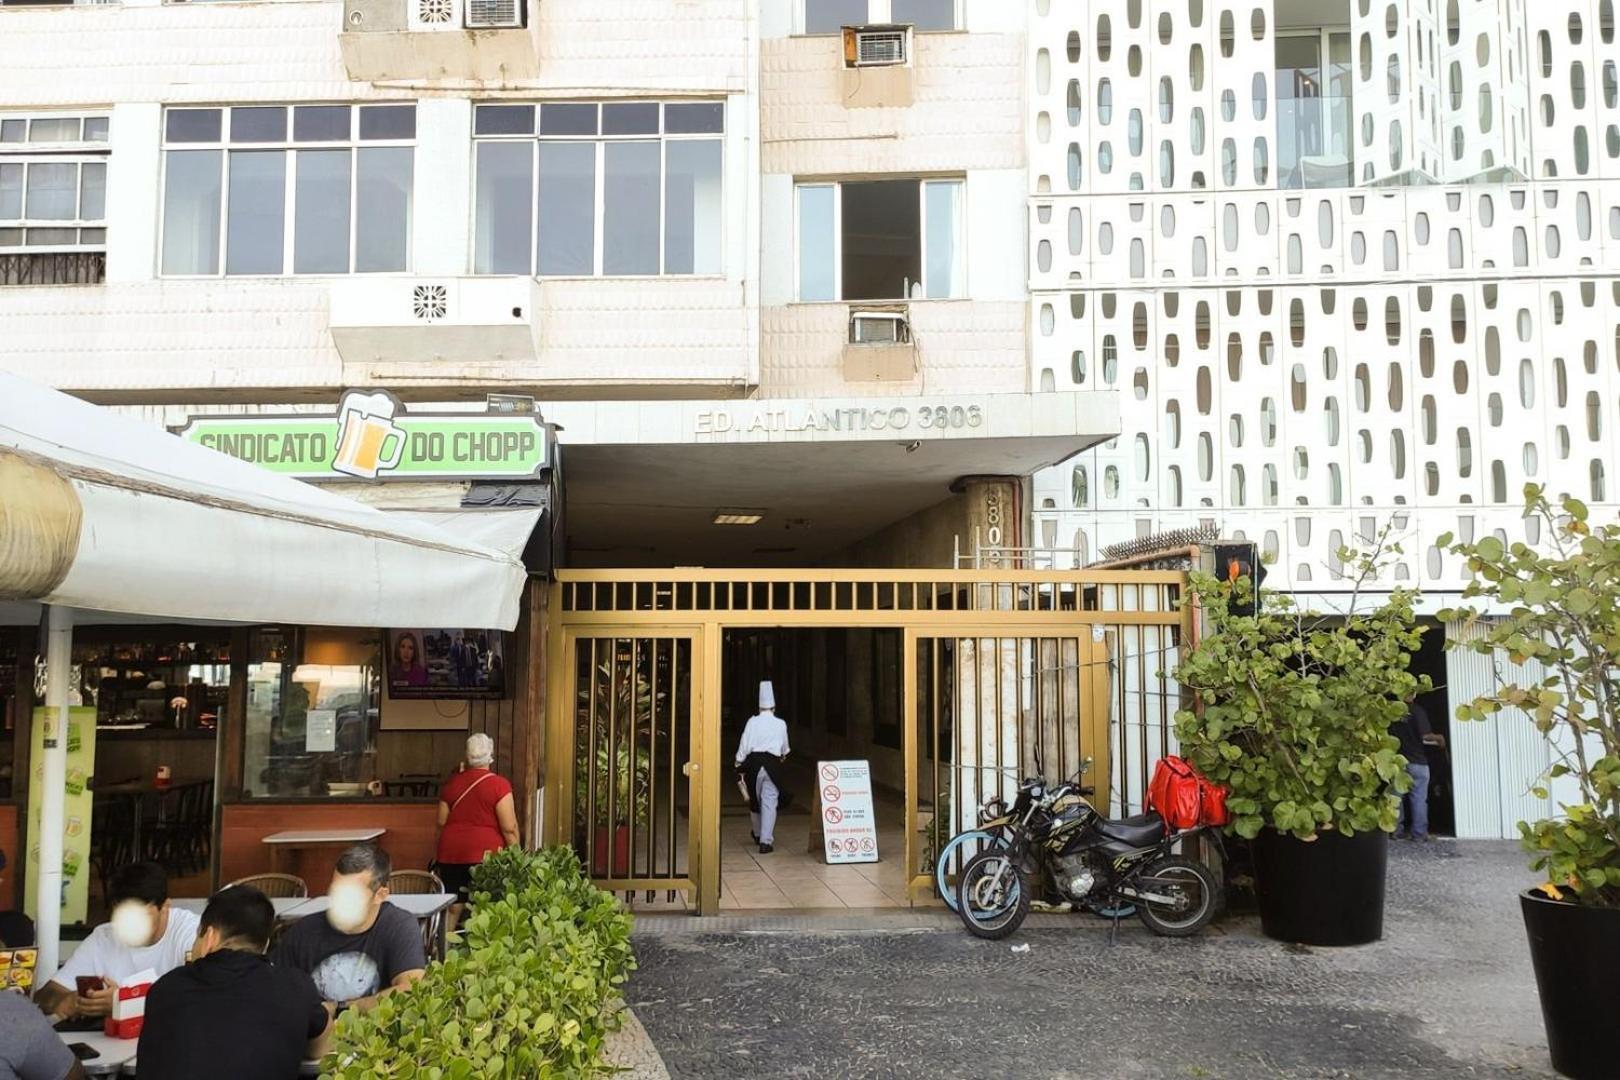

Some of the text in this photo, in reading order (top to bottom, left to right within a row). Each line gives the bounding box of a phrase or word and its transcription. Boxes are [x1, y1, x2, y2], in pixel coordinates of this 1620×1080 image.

[694, 405, 982, 433] ED. ATLANTICO 3806
[411, 432, 444, 462] DO
[452, 431, 535, 462] CHOPP
